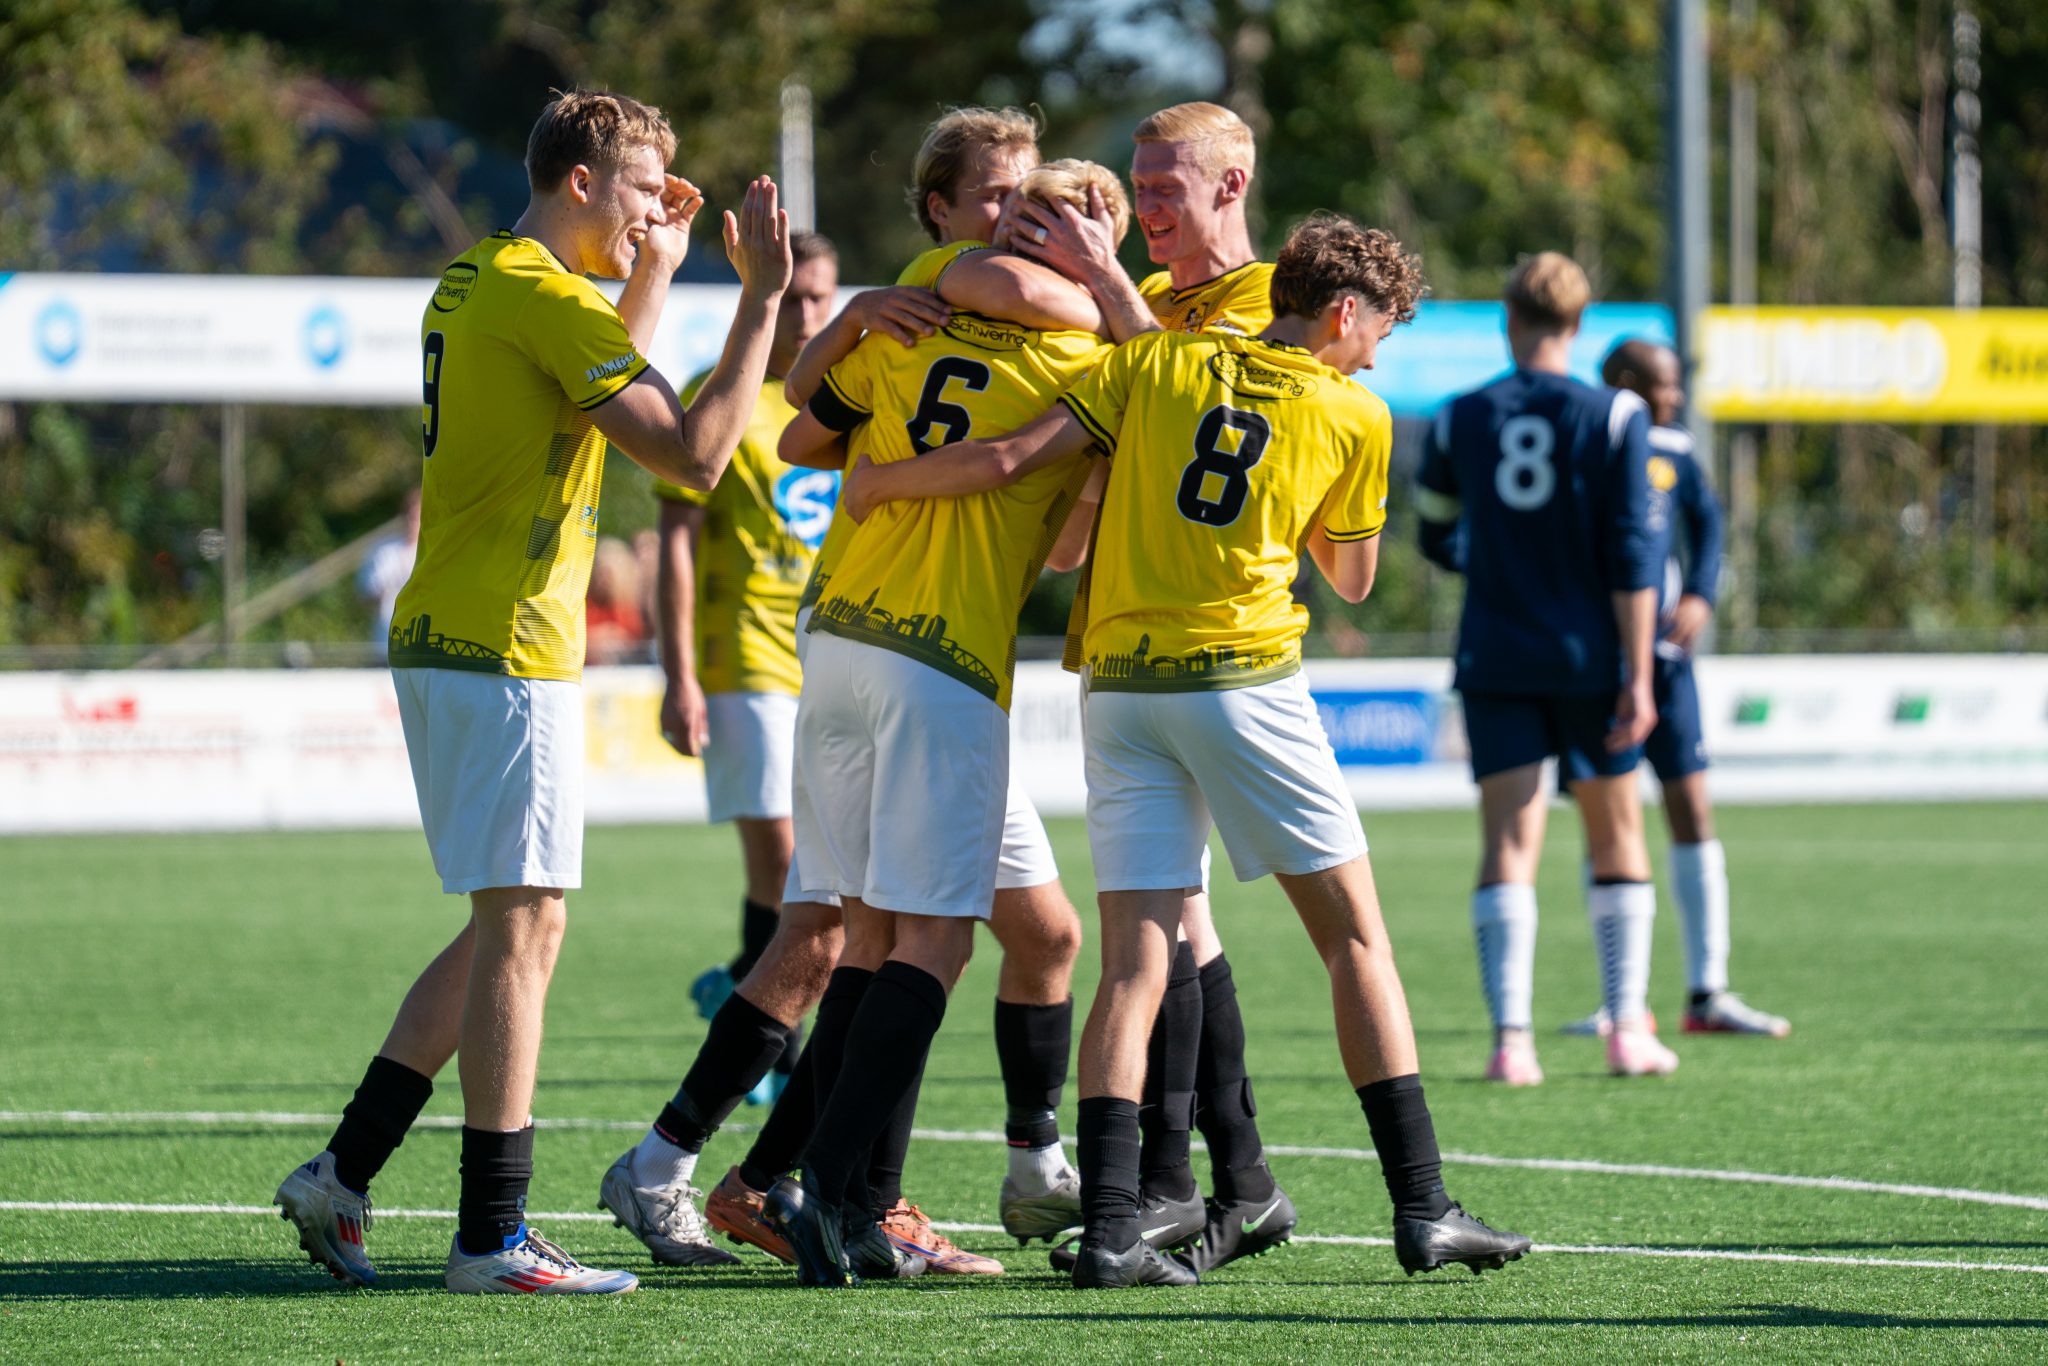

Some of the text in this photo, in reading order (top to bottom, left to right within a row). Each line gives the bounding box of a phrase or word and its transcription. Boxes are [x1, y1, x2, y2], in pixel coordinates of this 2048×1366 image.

[422, 330, 444, 458] 9
[584, 351, 636, 384] JUMBO
[906, 354, 990, 455] 6
[1701, 317, 1947, 405] JUMBO
[1176, 404, 1272, 527] 8
[1495, 414, 1557, 512] 8
